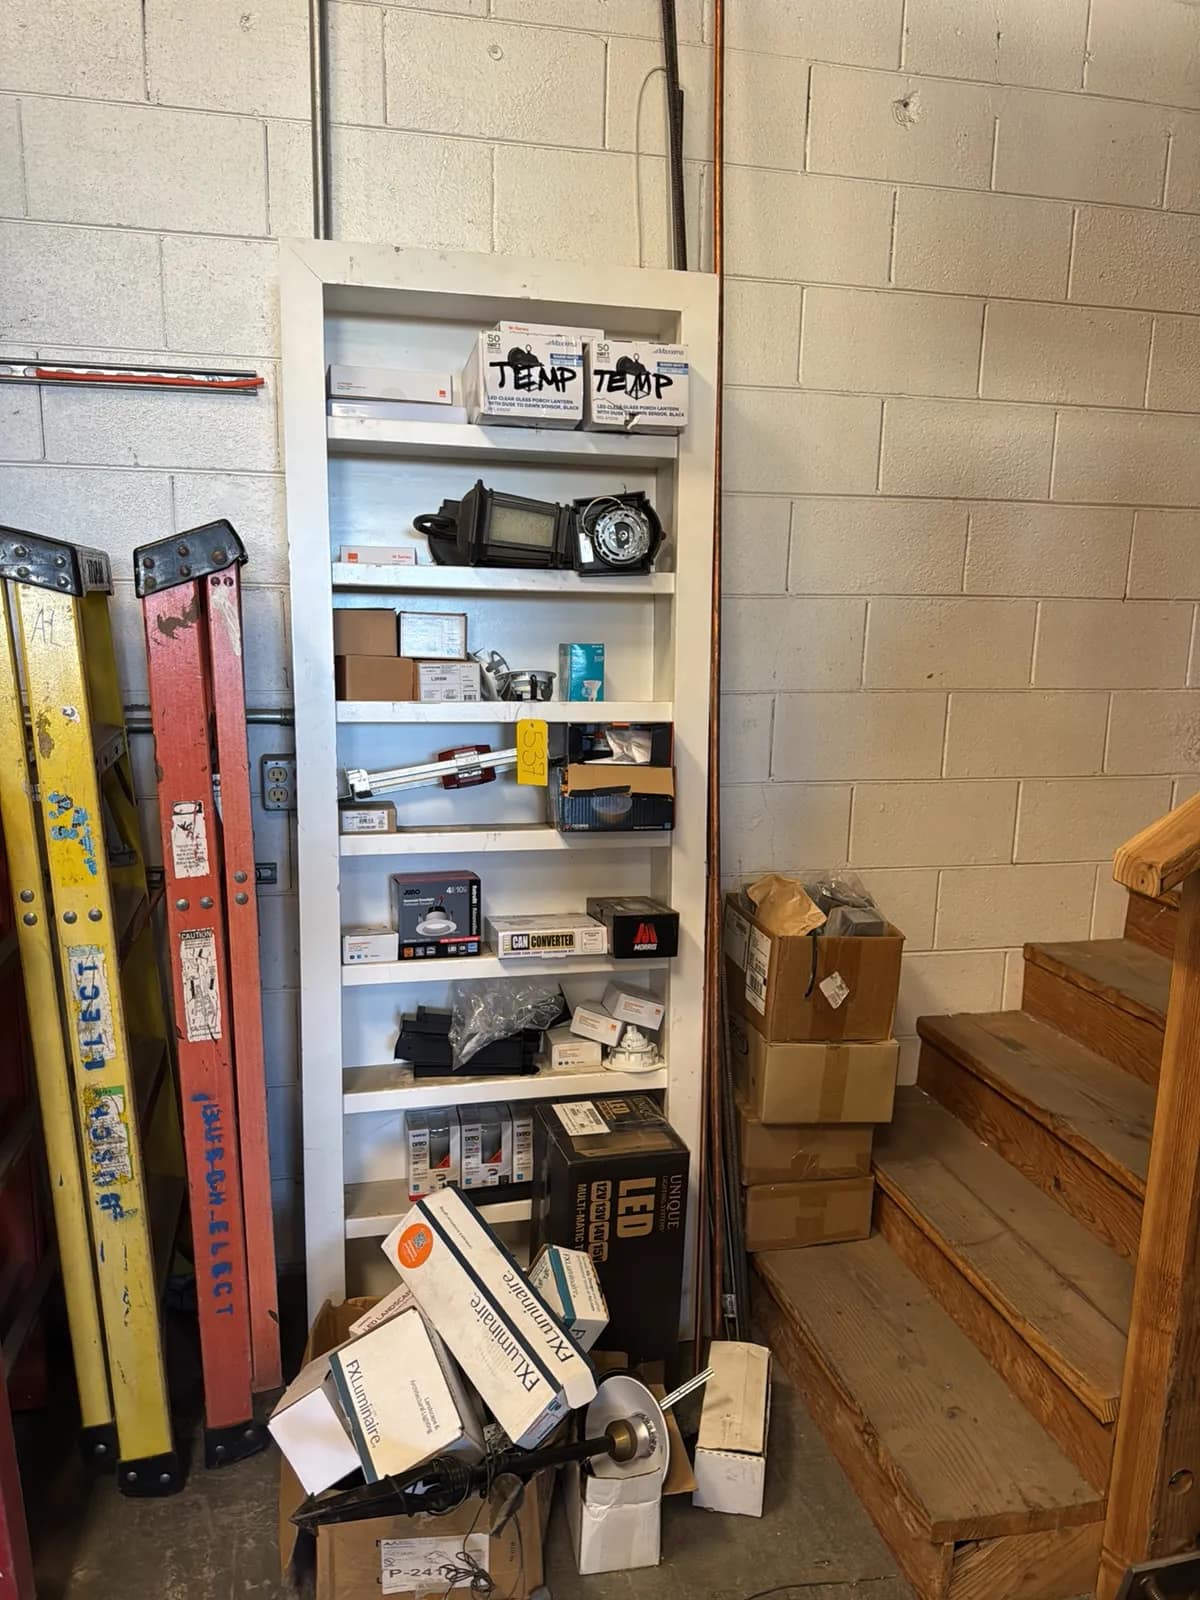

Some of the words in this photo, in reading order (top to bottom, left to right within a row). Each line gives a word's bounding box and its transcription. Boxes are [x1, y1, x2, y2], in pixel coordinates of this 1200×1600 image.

[487, 334, 500, 343] 50
[597, 343, 610, 352] 50
[489, 361, 577, 393] TEMP
[593, 369, 673, 400] TEMP
[181, 930, 212, 940] CAUTION
[512, 936, 529, 950] CAN
[530, 935, 574, 948] CONVERTER
[596, 1183, 607, 1200] 12V
[595, 1202, 607, 1220] 13V
[617, 1177, 657, 1239] LED
[667, 1174, 683, 1231] UNIQUE
[575, 1183, 587, 1243] MULTI-MATIC
[594, 1223, 605, 1242] 14V
[592, 1243, 603, 1262] 15V
